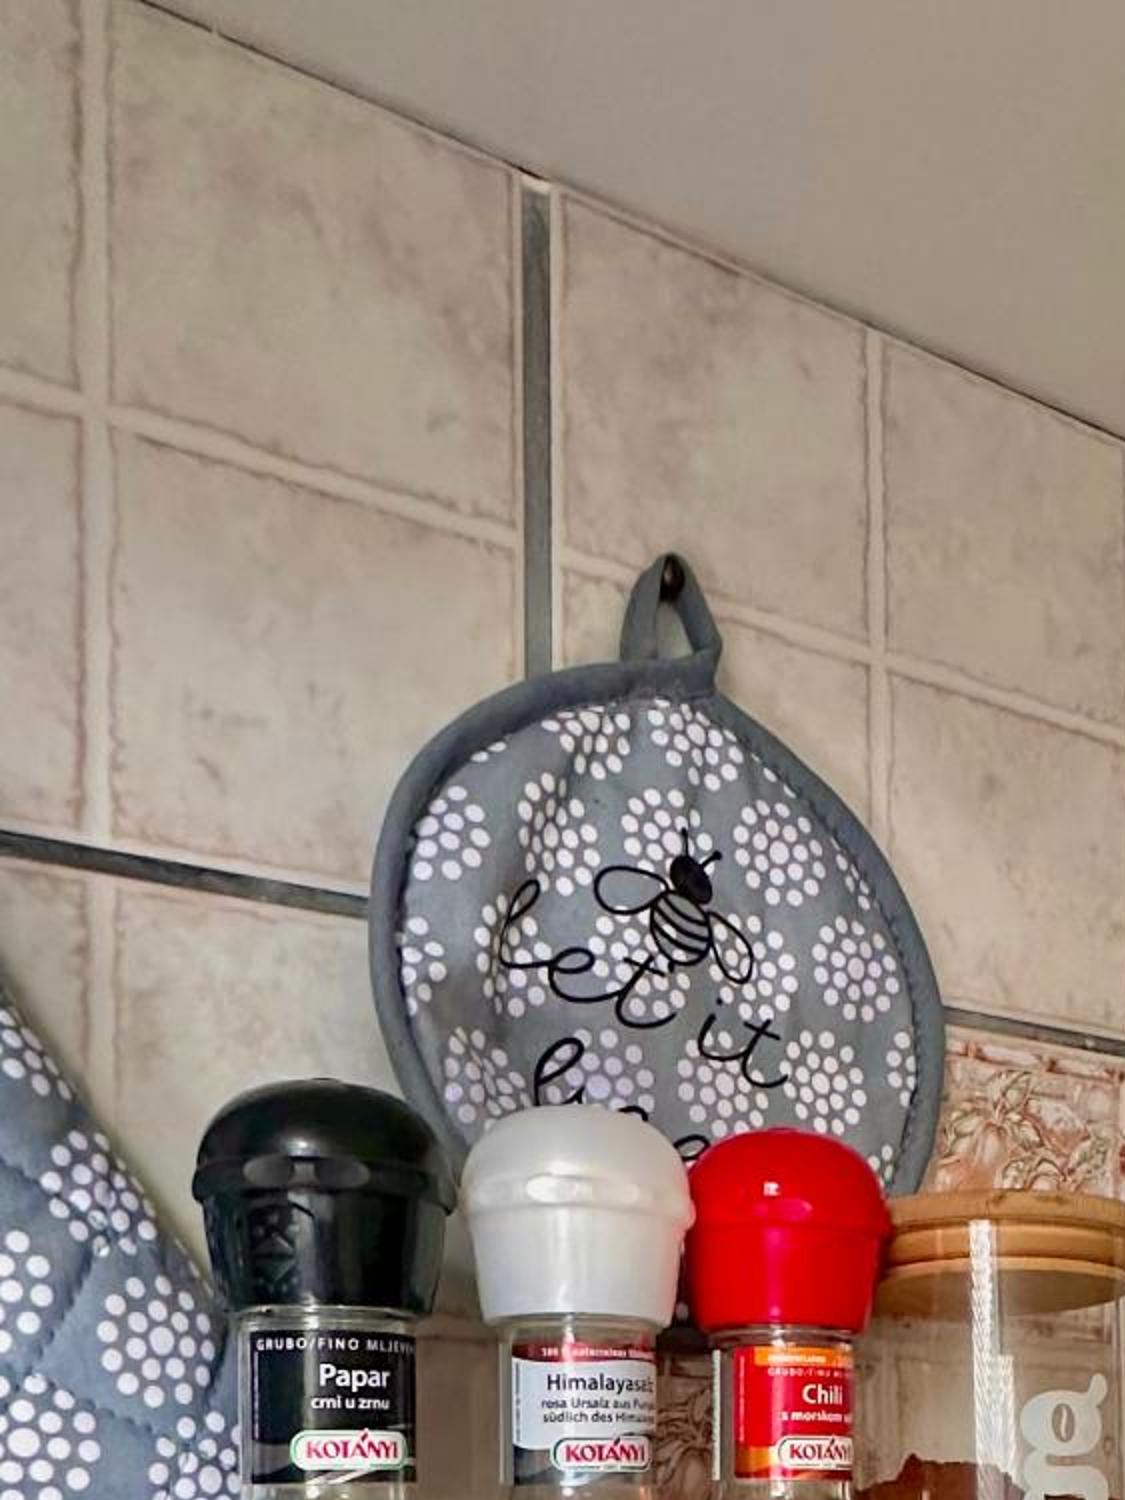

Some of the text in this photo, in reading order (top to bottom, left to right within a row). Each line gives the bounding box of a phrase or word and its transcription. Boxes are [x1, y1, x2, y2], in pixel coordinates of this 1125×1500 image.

[698, 996, 790, 1089] it
[255, 1337, 360, 1351] GRUBO/FINO
[318, 1363, 392, 1393] Papar
[310, 1395, 391, 1411] crni u zrnu
[802, 1383, 844, 1405] Chili
[543, 1410, 589, 1423] südlich
[591, 1410, 613, 1423] des
[305, 1432, 399, 1459] KOTÁNYI
[565, 1437, 646, 1462] KOTÁNYI
